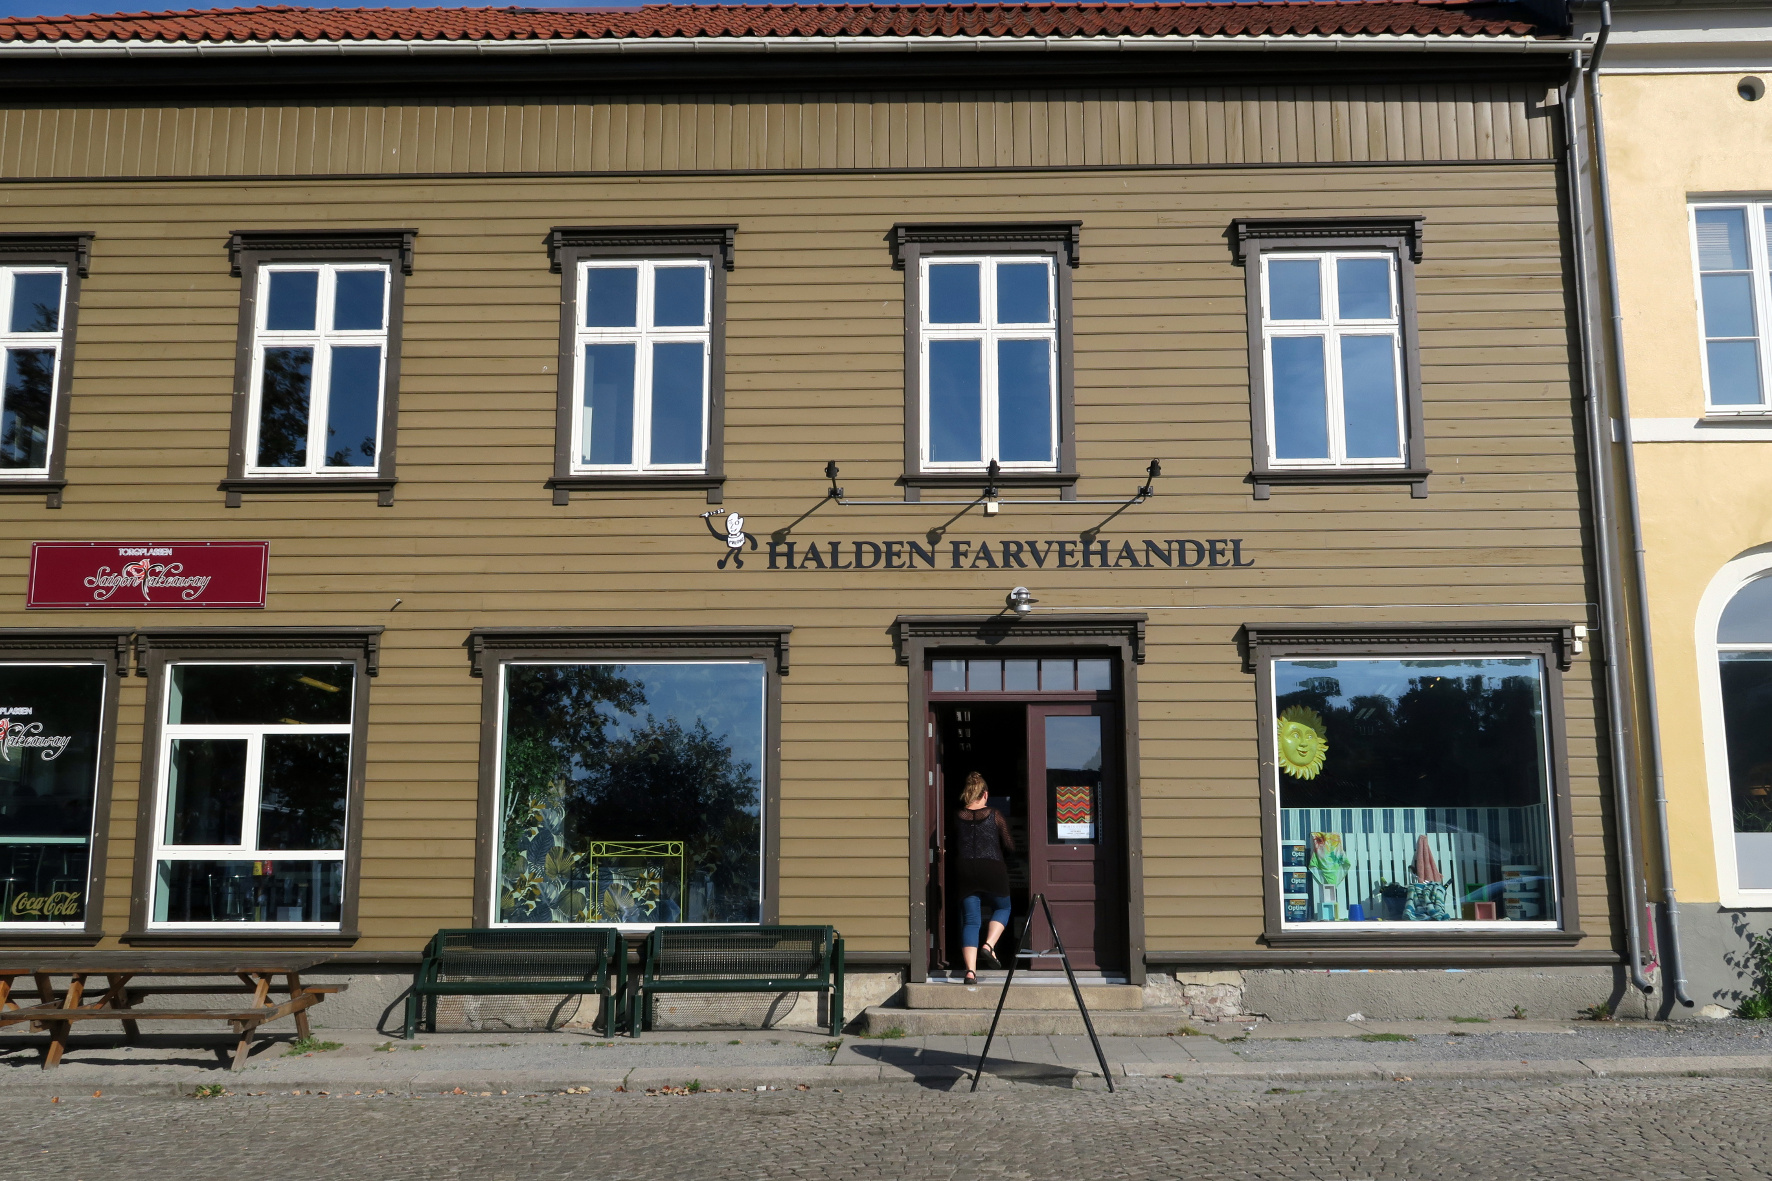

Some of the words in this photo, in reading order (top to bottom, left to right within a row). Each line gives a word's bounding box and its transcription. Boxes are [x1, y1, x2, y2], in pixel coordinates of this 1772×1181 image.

[118, 547, 173, 556] TORGPLASSEN
[766, 541, 935, 569] HALDEN
[949, 538, 1255, 569] FARVEHANDEL
[84, 565, 140, 601] Saigon
[138, 559, 212, 601] Takeaway
[11, 891, 81, 916] Coca-Cola
